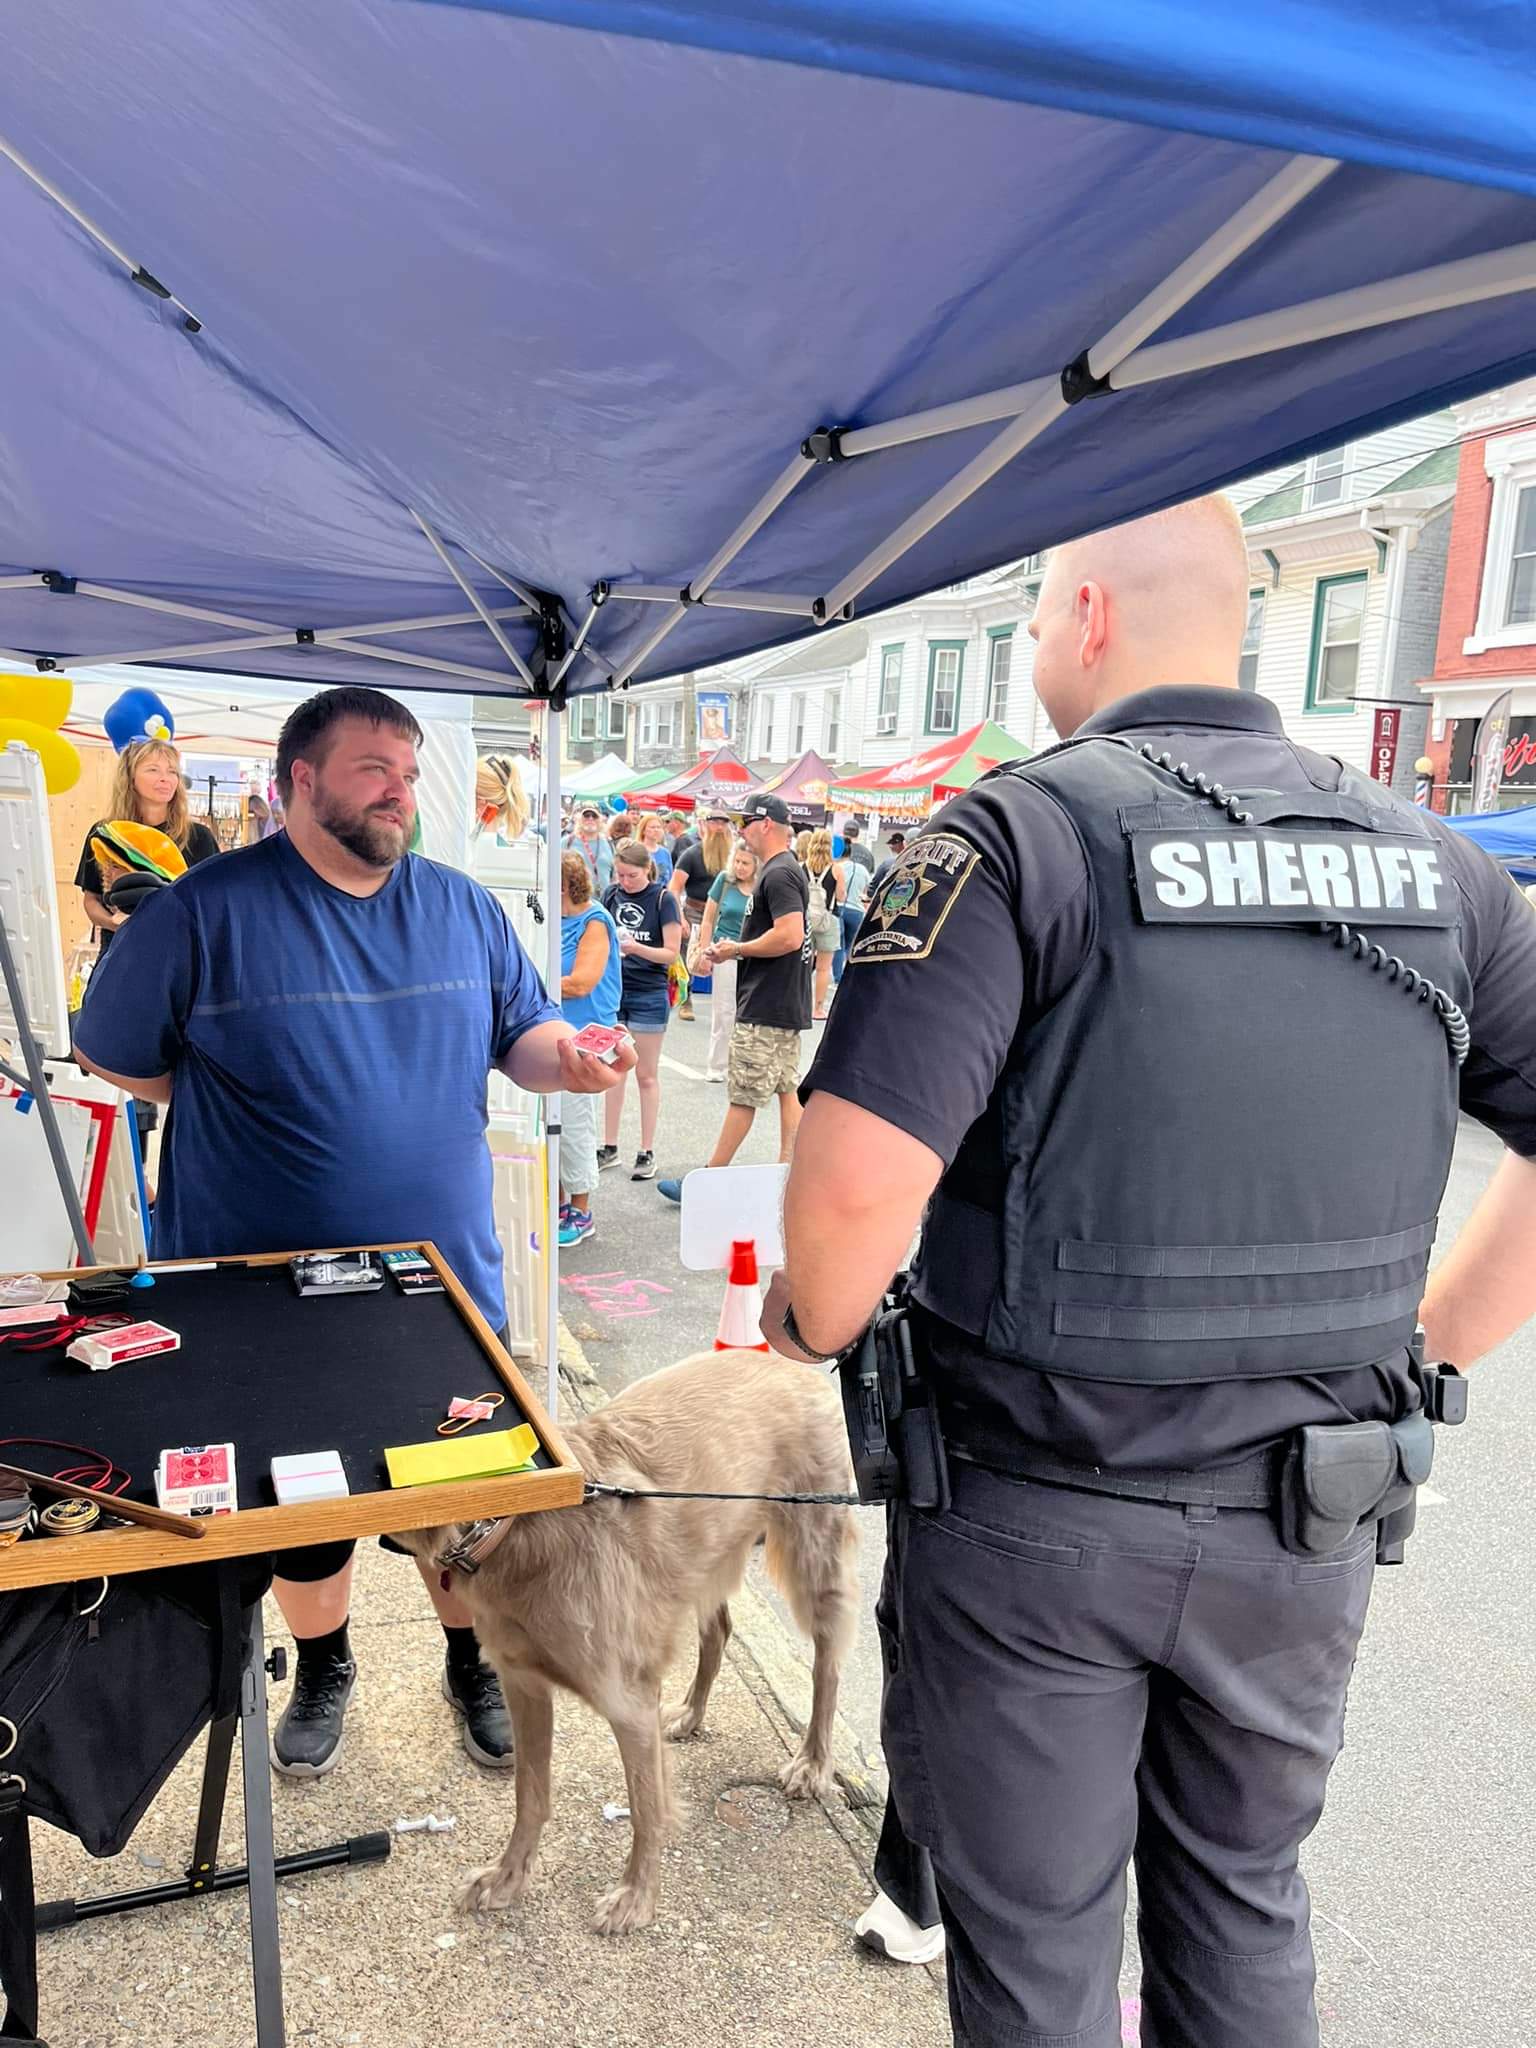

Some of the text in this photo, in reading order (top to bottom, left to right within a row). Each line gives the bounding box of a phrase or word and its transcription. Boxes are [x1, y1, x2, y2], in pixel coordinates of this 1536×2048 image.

[1378, 748, 1391, 784] OPE
[897, 840, 969, 875] ERIFF
[1150, 840, 1444, 910] SHERIFF
[629, 930, 651, 941] TATE
